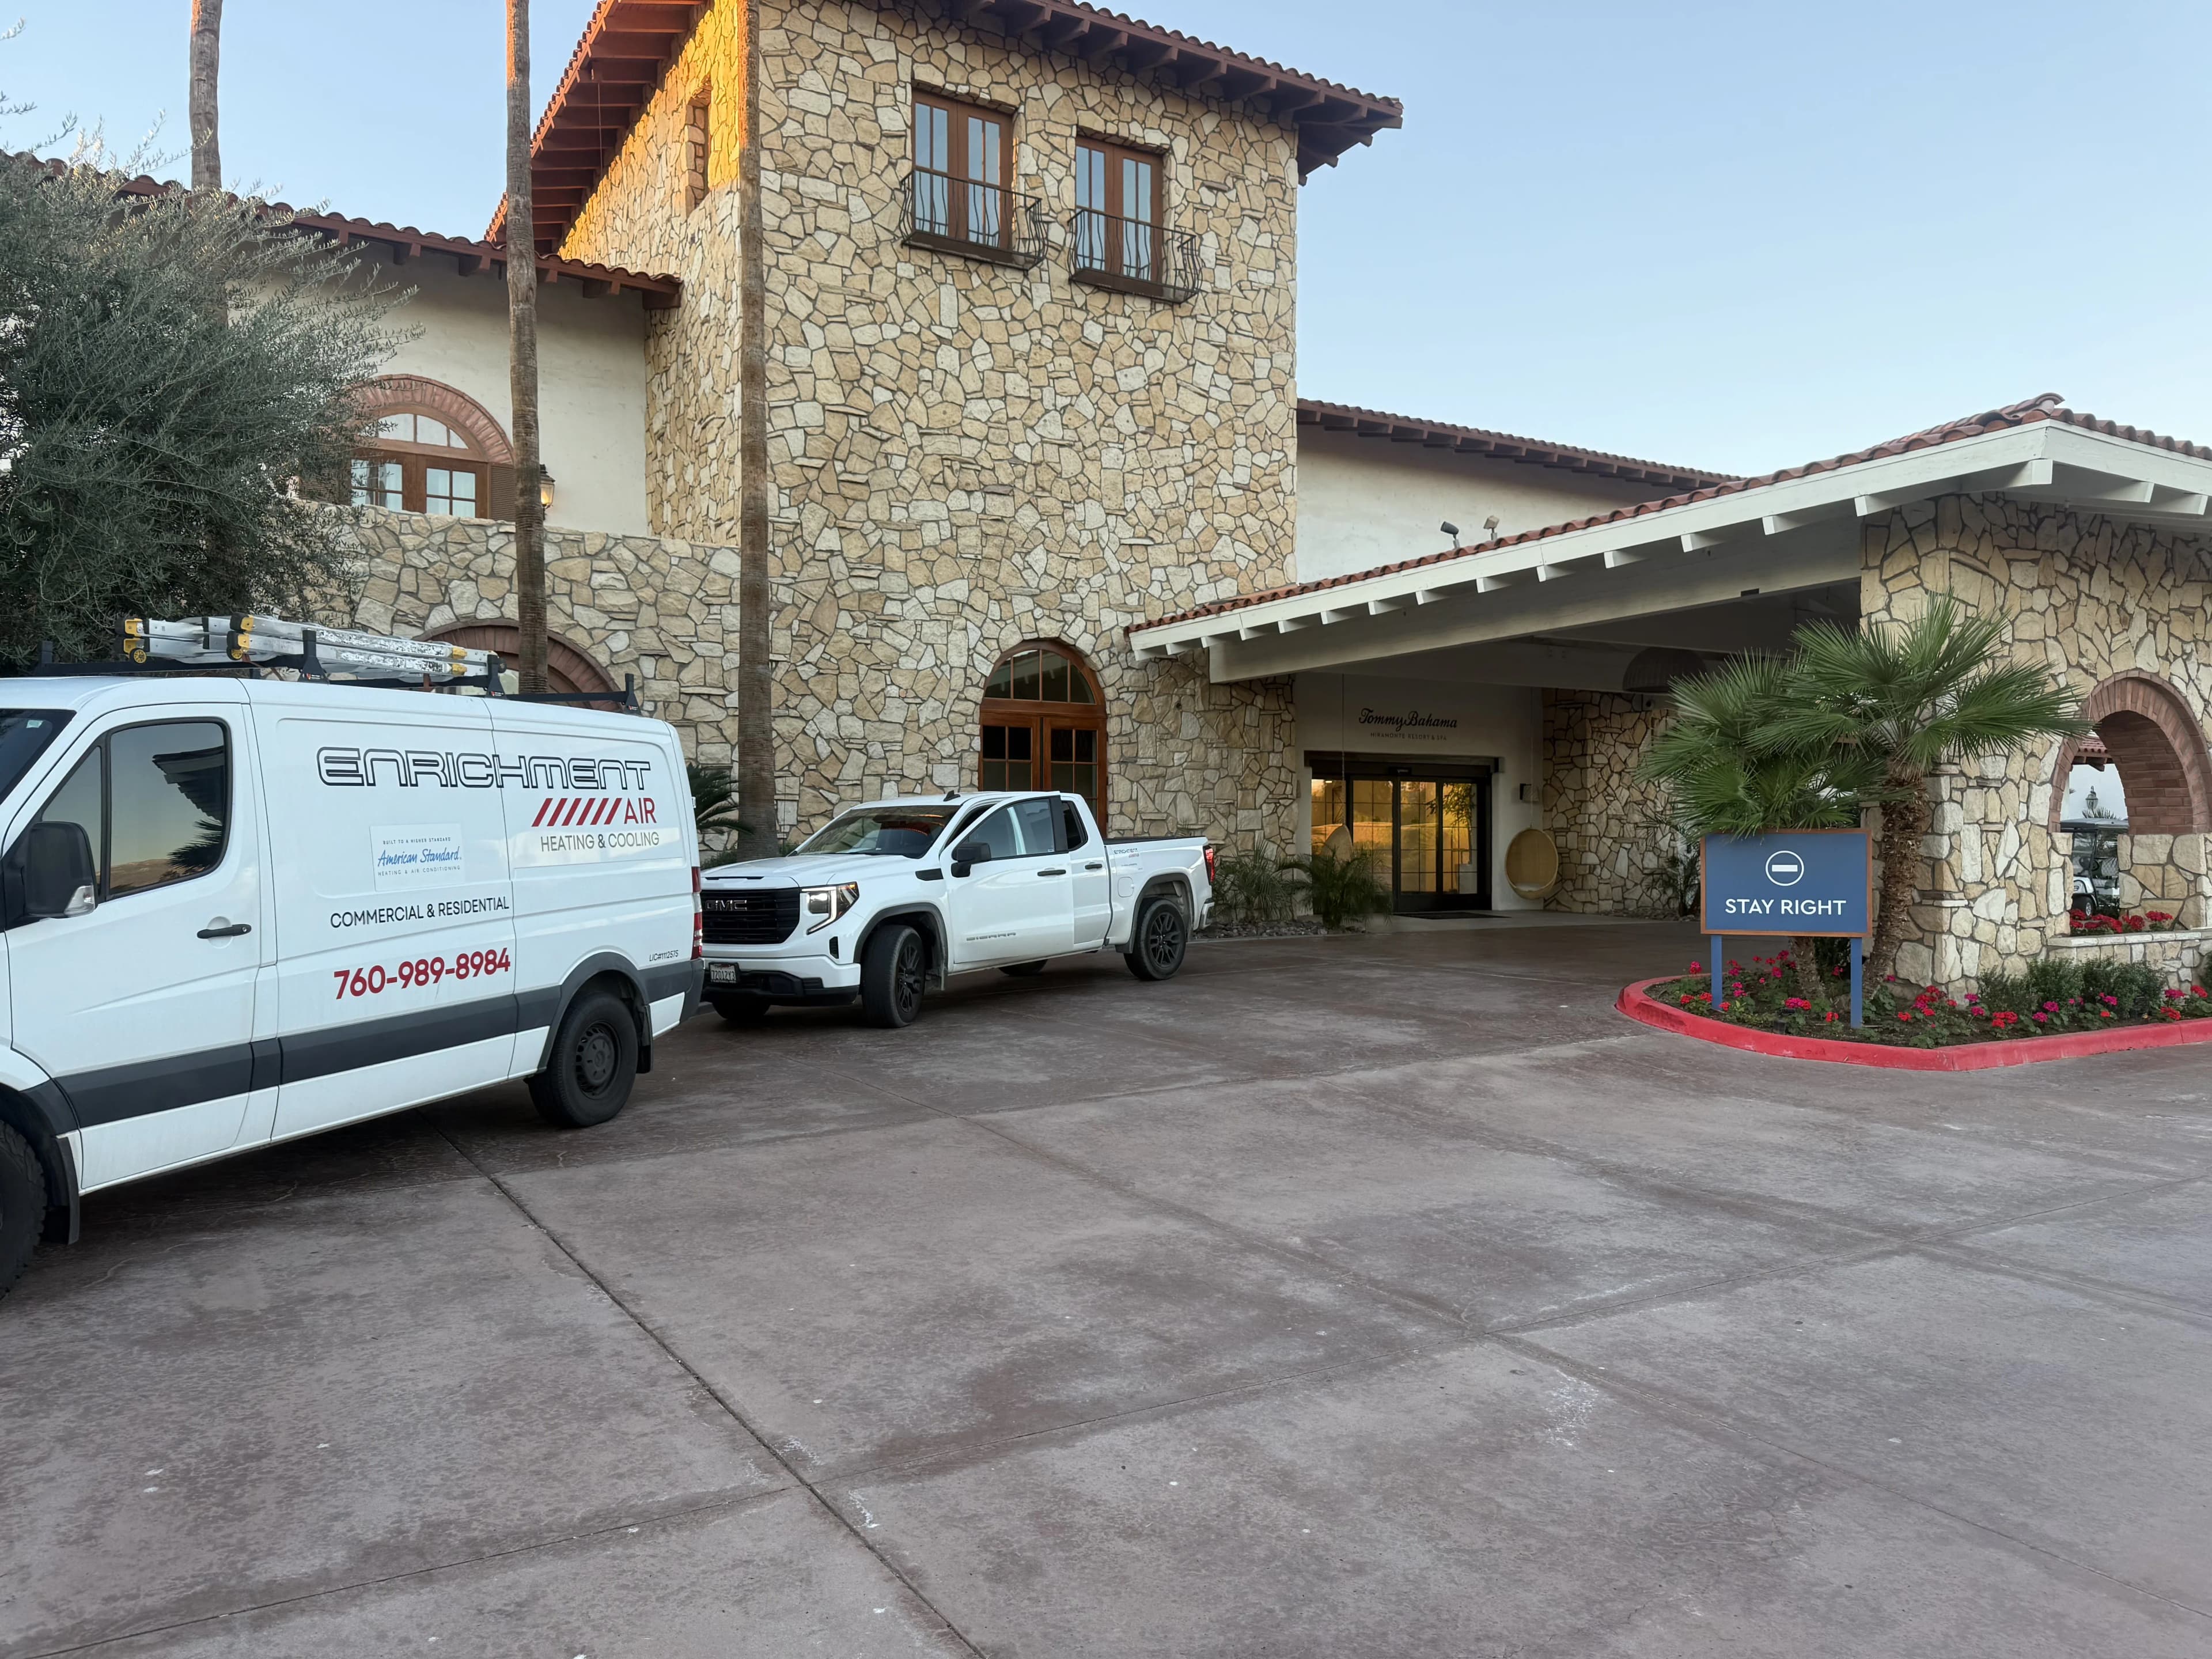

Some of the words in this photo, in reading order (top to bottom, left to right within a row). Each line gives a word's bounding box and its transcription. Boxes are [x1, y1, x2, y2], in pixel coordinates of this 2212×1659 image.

[1358, 707, 1403, 732] Tommy
[1405, 710, 1457, 729] Bahama
[317, 747, 652, 790] ENRICHMENT
[623, 797, 657, 824] AIR
[540, 834, 595, 852] HEATING
[597, 834, 606, 849] &
[608, 831, 660, 848] COOLING
[377, 849, 418, 867] American
[330, 904, 424, 928] COMMERCIAL
[426, 903, 435, 918] &
[438, 896, 509, 916] RESIDENTIAL
[705, 900, 747, 911] GMC
[1725, 899, 1774, 914] STAY
[1781, 899, 1847, 915] RIGHT
[334, 948, 511, 999] 760-989-8984
